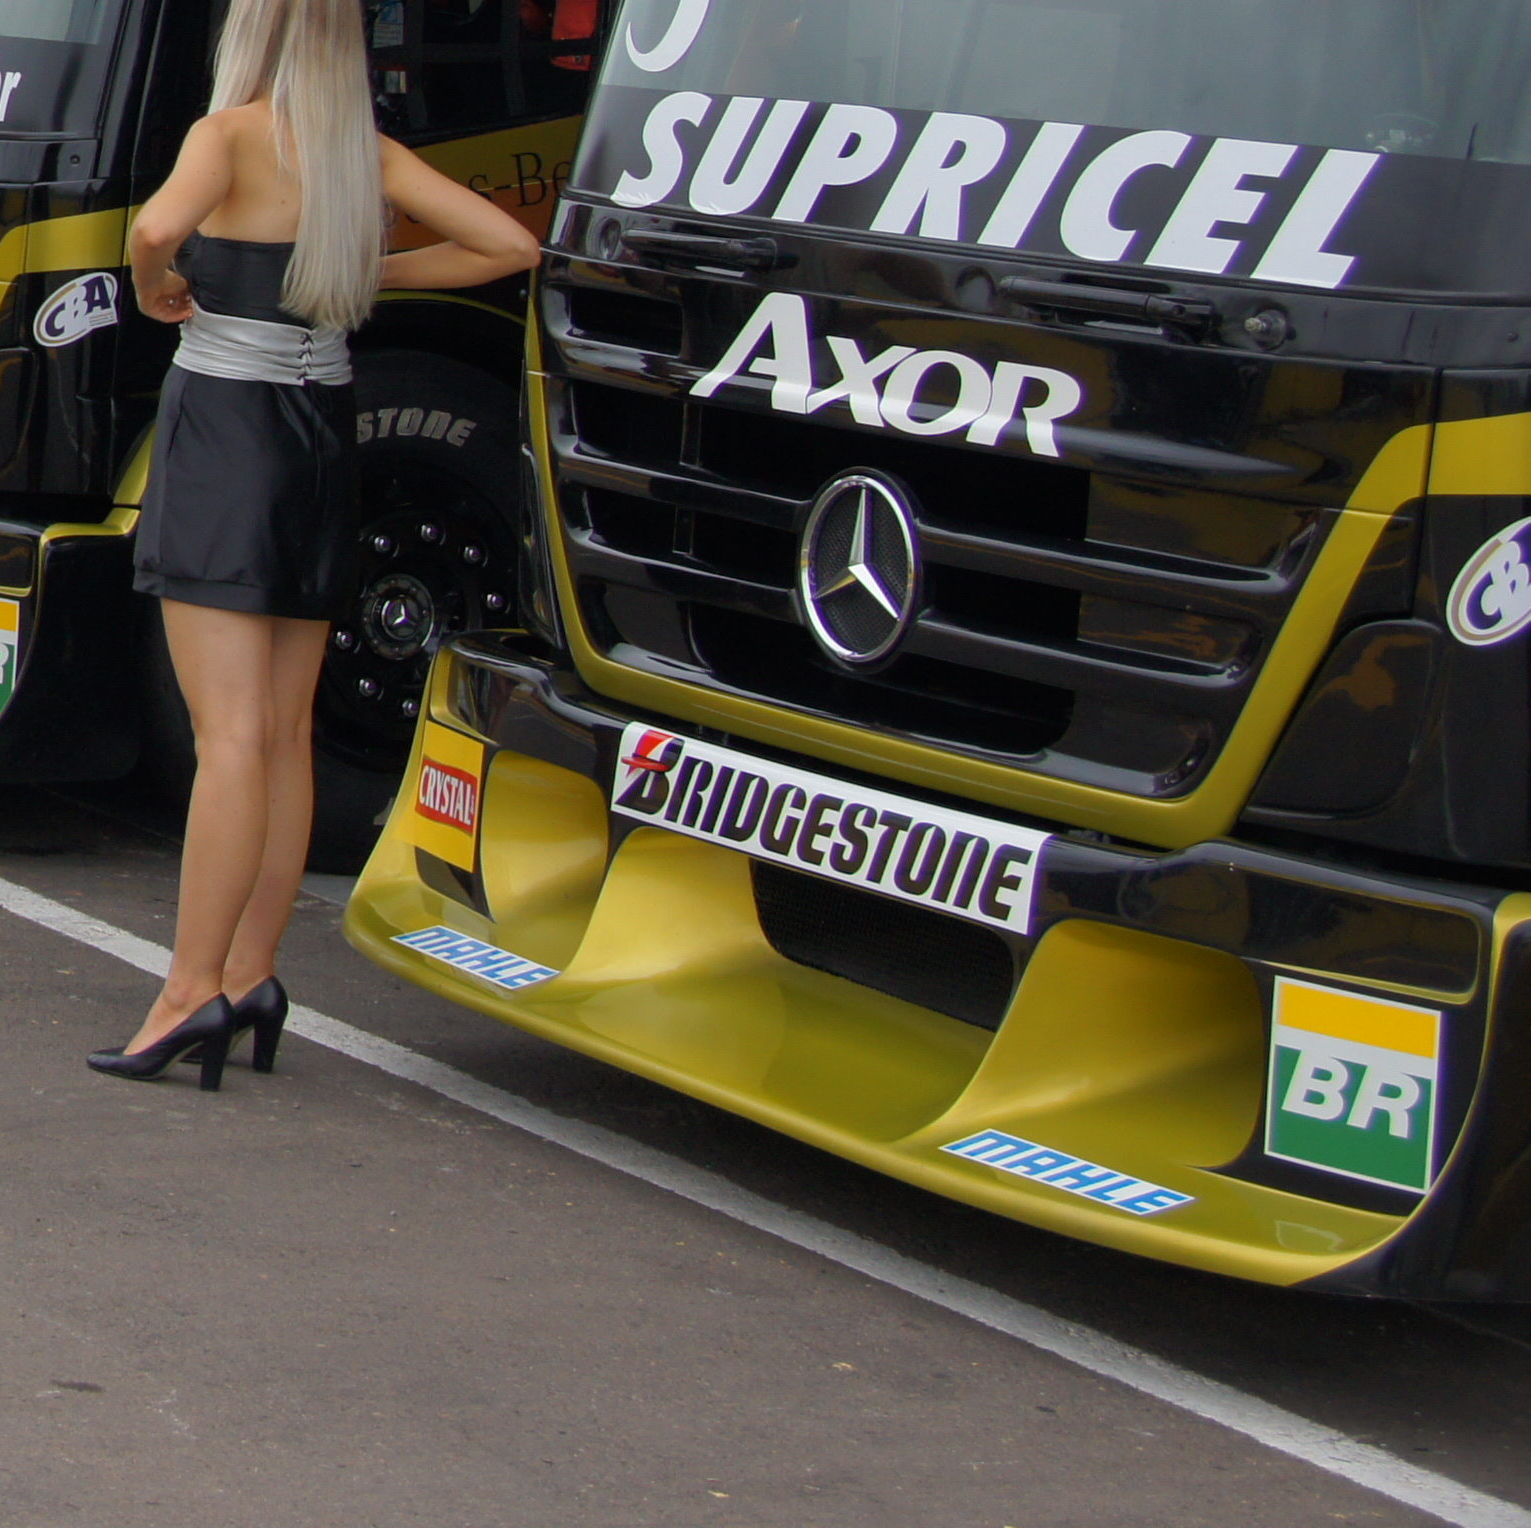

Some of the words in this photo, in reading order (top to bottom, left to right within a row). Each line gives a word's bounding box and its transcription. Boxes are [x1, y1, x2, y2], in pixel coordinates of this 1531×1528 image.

[609, 89, 1382, 291] SUPRICEL
[45, 275, 113, 338] CBA
[418, 764, 473, 826] CRYSTAL
[613, 728, 1035, 924] BRIDGESTONE
[395, 927, 555, 988] MAHLE
[1280, 1050, 1427, 1142] BR
[947, 1131, 1187, 1212] MAHLE
